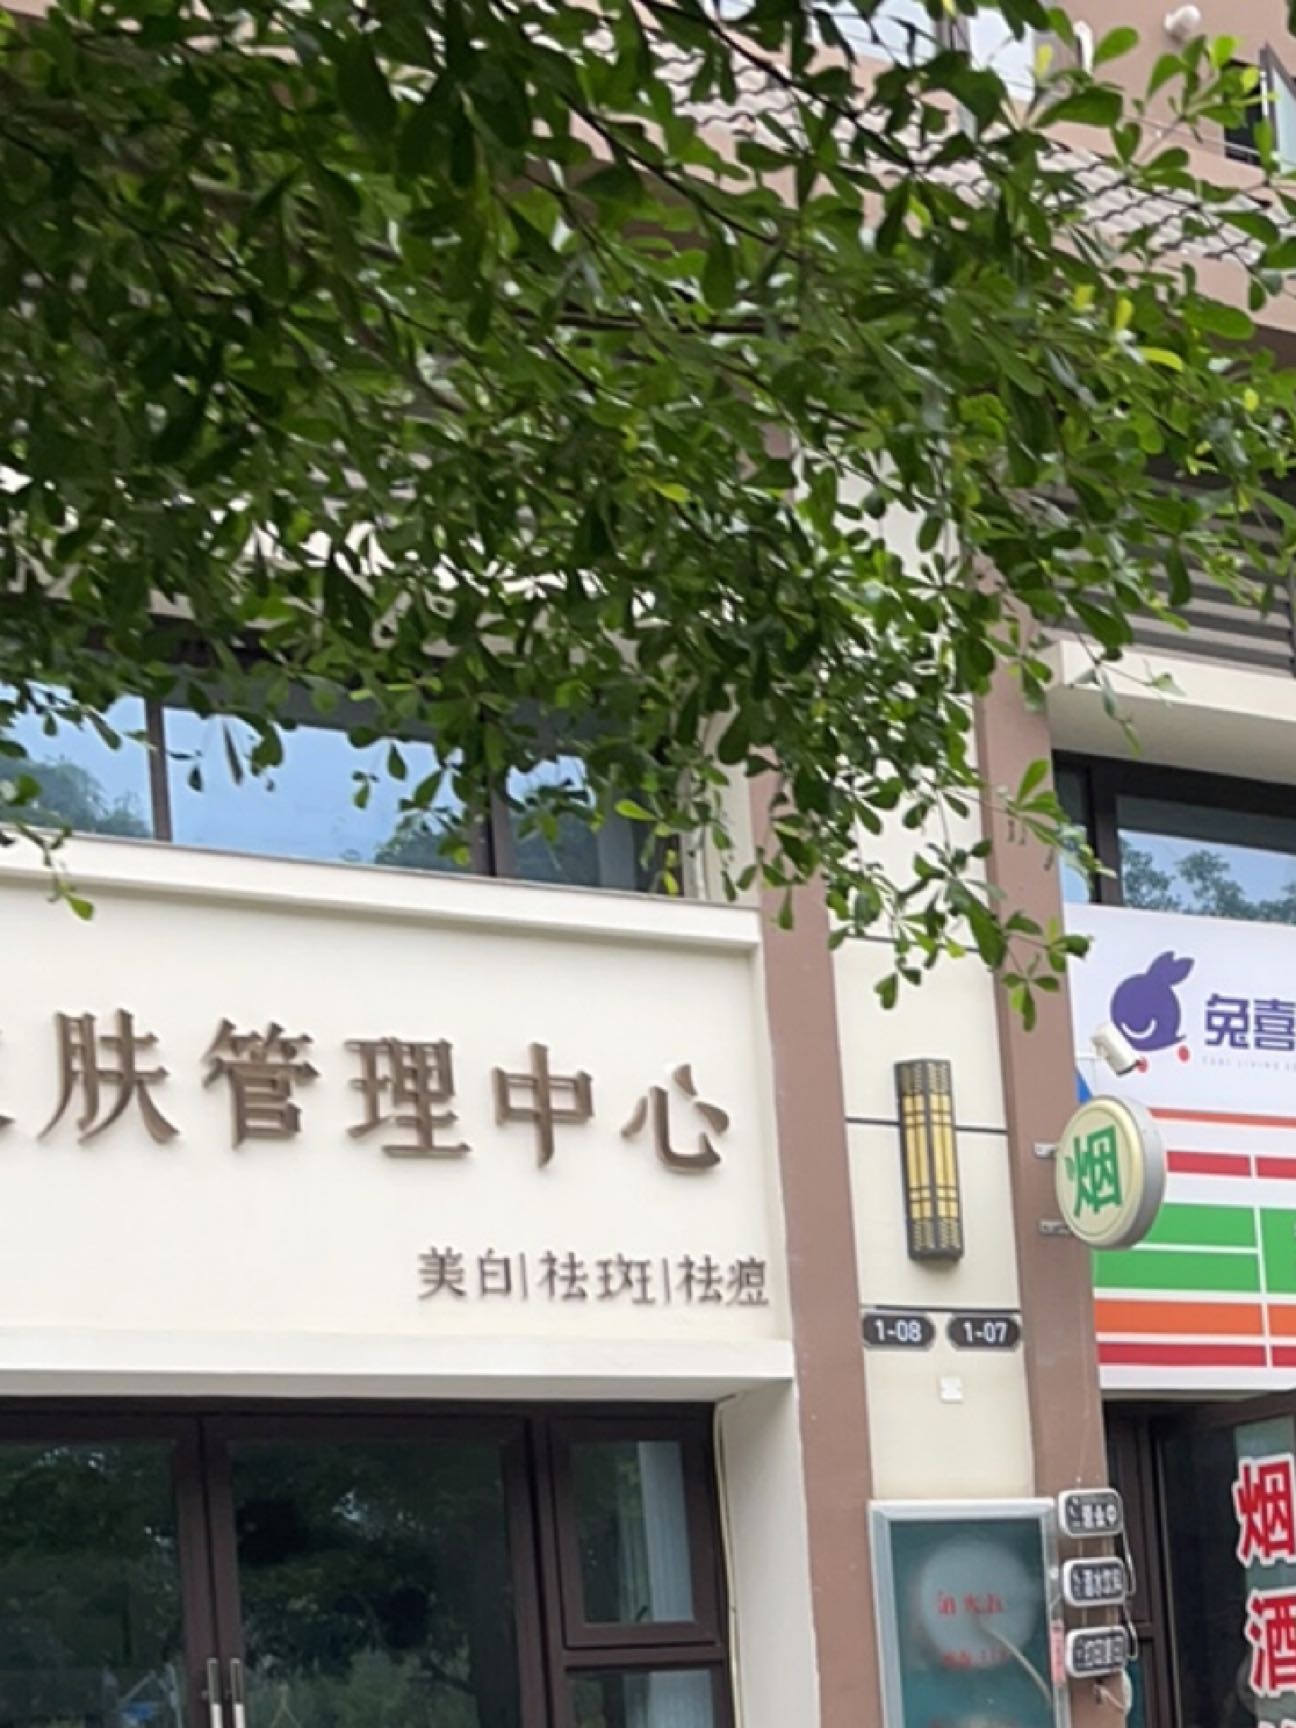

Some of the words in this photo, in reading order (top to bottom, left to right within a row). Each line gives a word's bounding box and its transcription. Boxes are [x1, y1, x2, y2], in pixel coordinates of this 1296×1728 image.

[0, 1008, 730, 1175] 肤管理中心
[1064, 1124, 1123, 1218] 烟
[875, 1318, 922, 1342] 1-08
[963, 1320, 1008, 1343] 1-07
